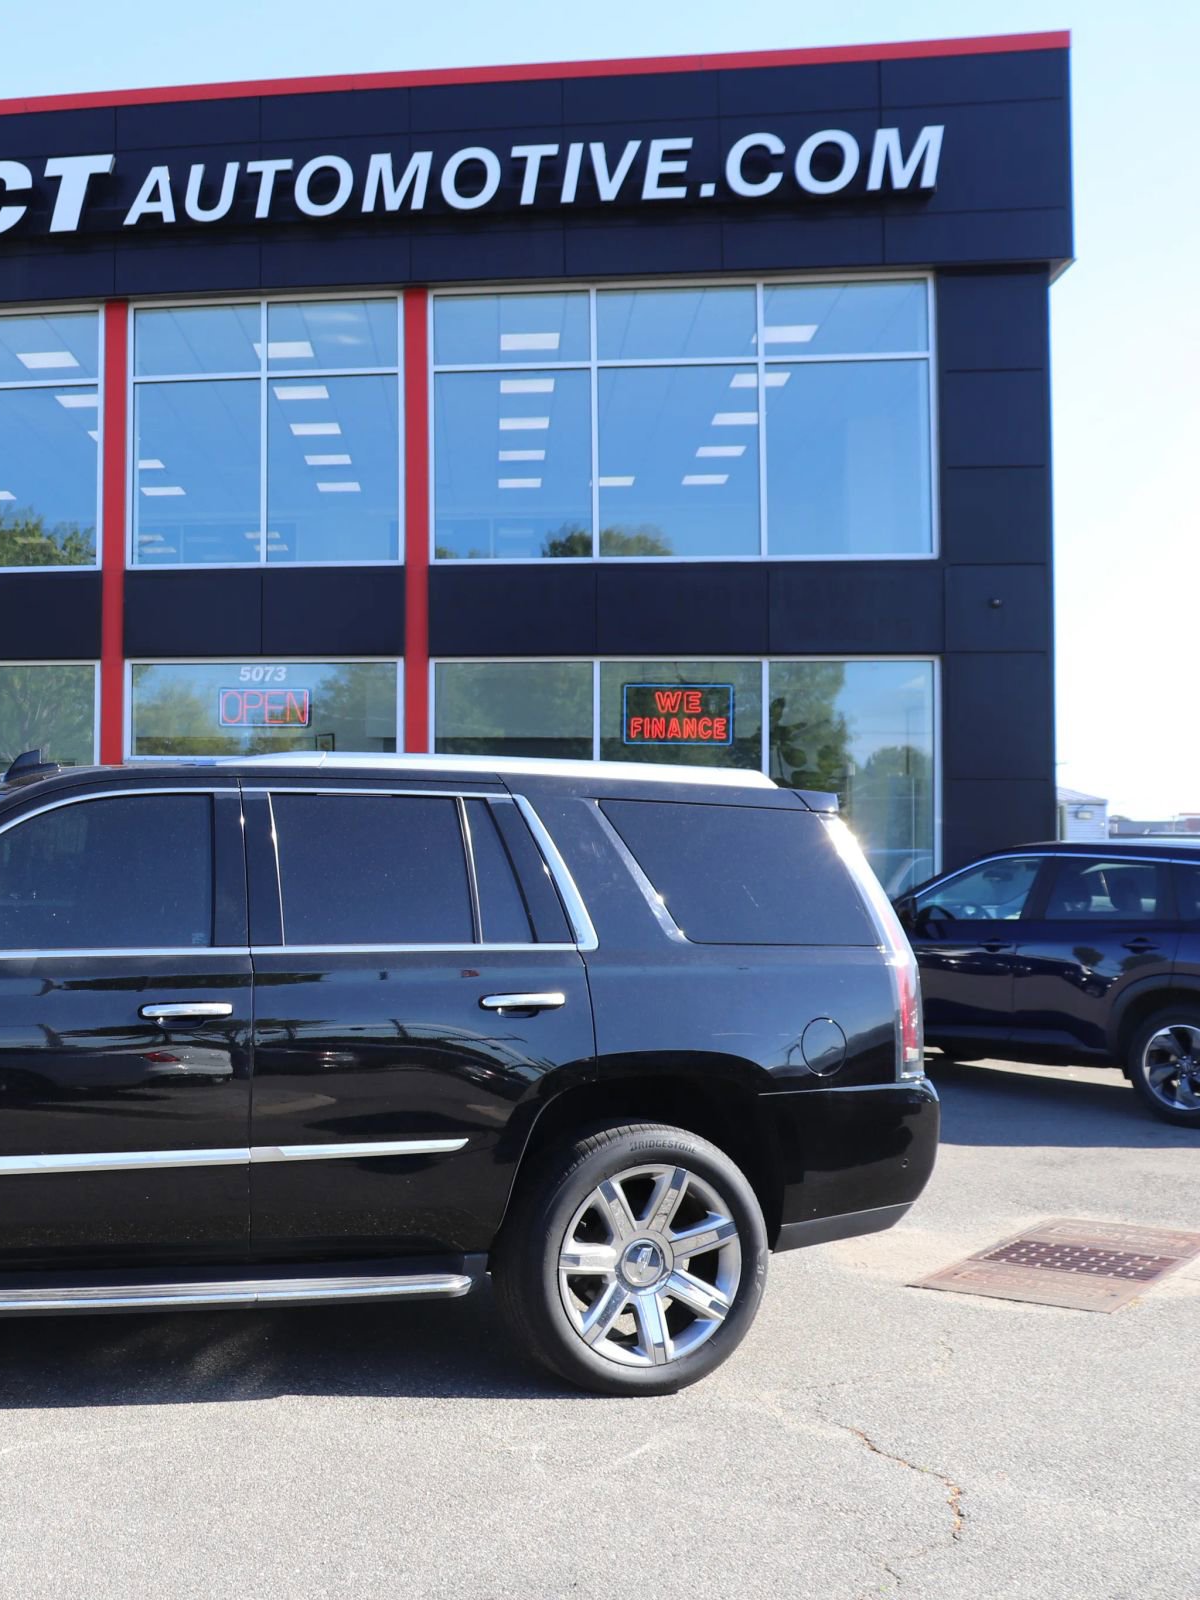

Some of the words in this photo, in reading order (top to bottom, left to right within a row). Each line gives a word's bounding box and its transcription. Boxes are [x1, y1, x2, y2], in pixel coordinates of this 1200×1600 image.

[123, 125, 945, 226] AUTOMOTIVE.COM
[239, 666, 287, 682] 5073
[222, 690, 307, 724] OPEN
[655, 691, 702, 713] WE
[630, 717, 727, 740] FINANCE
